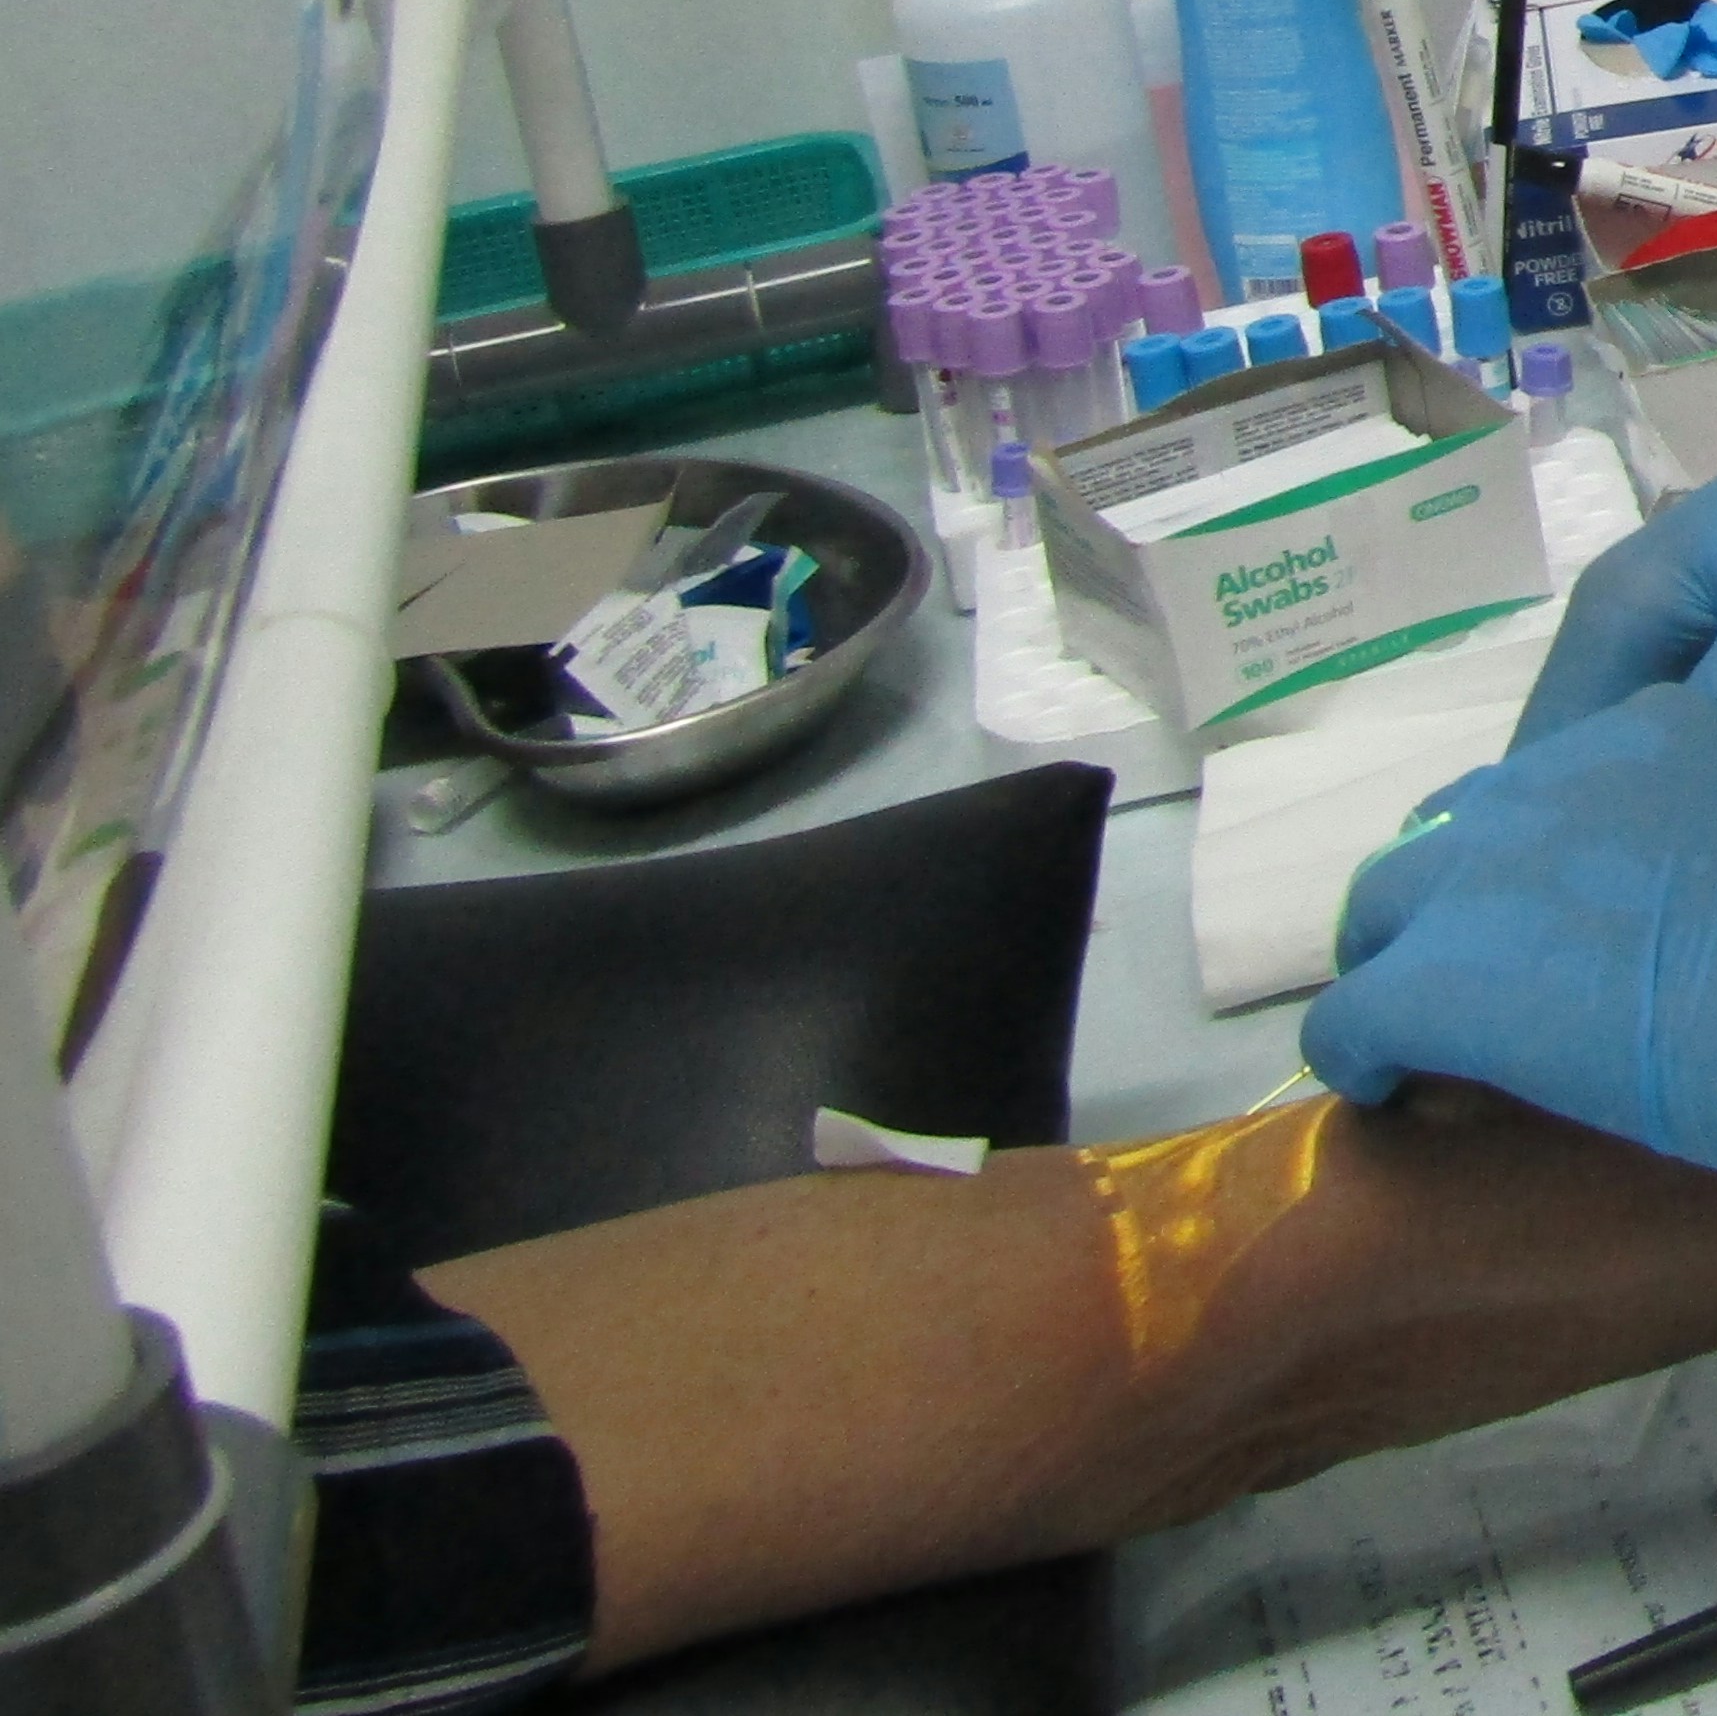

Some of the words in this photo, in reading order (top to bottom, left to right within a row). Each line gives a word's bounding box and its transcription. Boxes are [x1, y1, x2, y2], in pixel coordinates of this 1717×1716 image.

[1380, 9, 1407, 68] MARKER
[1397, 72, 1437, 168] Permanent
[1427, 183, 1471, 281] SNOWMAN
[1534, 267, 1579, 287] FREE
[1215, 534, 1339, 602] Alcohol
[1223, 575, 1331, 628] Swabs
